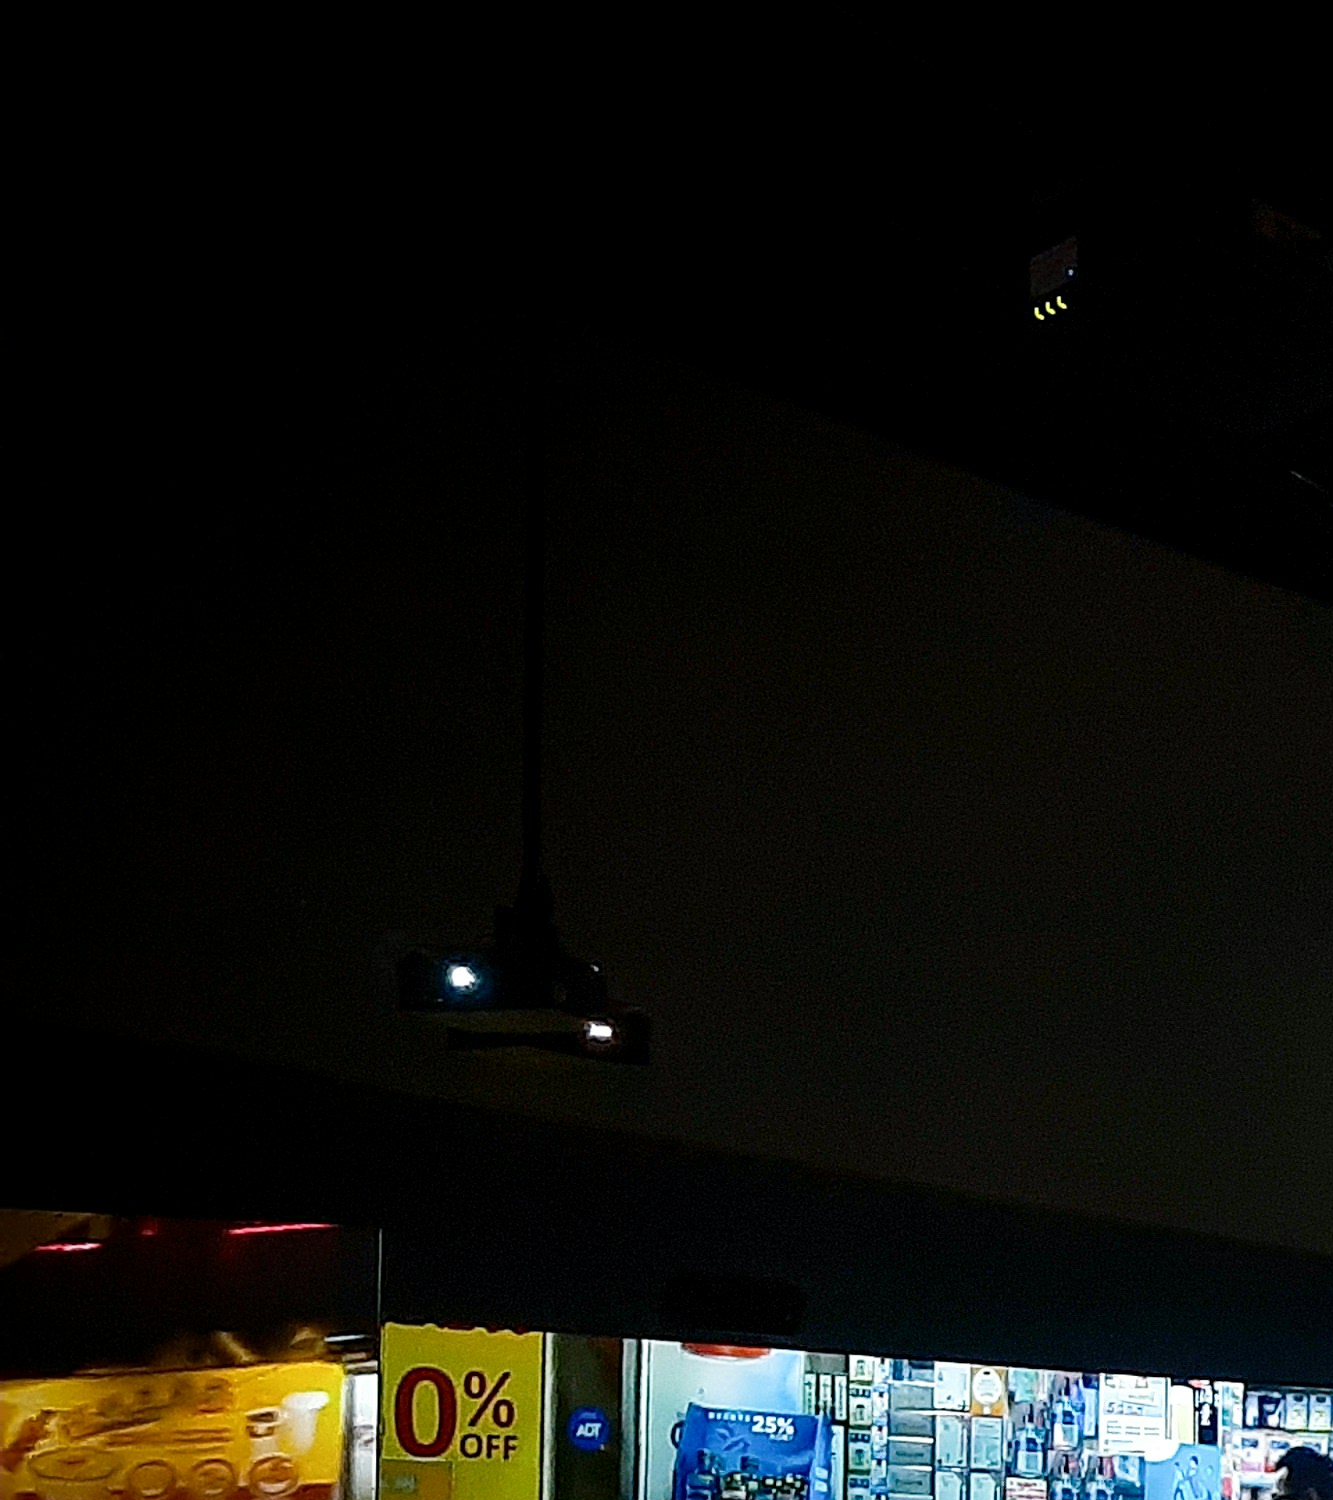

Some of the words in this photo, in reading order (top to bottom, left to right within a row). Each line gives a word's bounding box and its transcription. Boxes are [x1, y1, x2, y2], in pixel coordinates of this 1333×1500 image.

[576, 1422, 602, 1439] ADT
[752, 1415, 795, 1435] 25%
[460, 1433, 518, 1460] OFF
